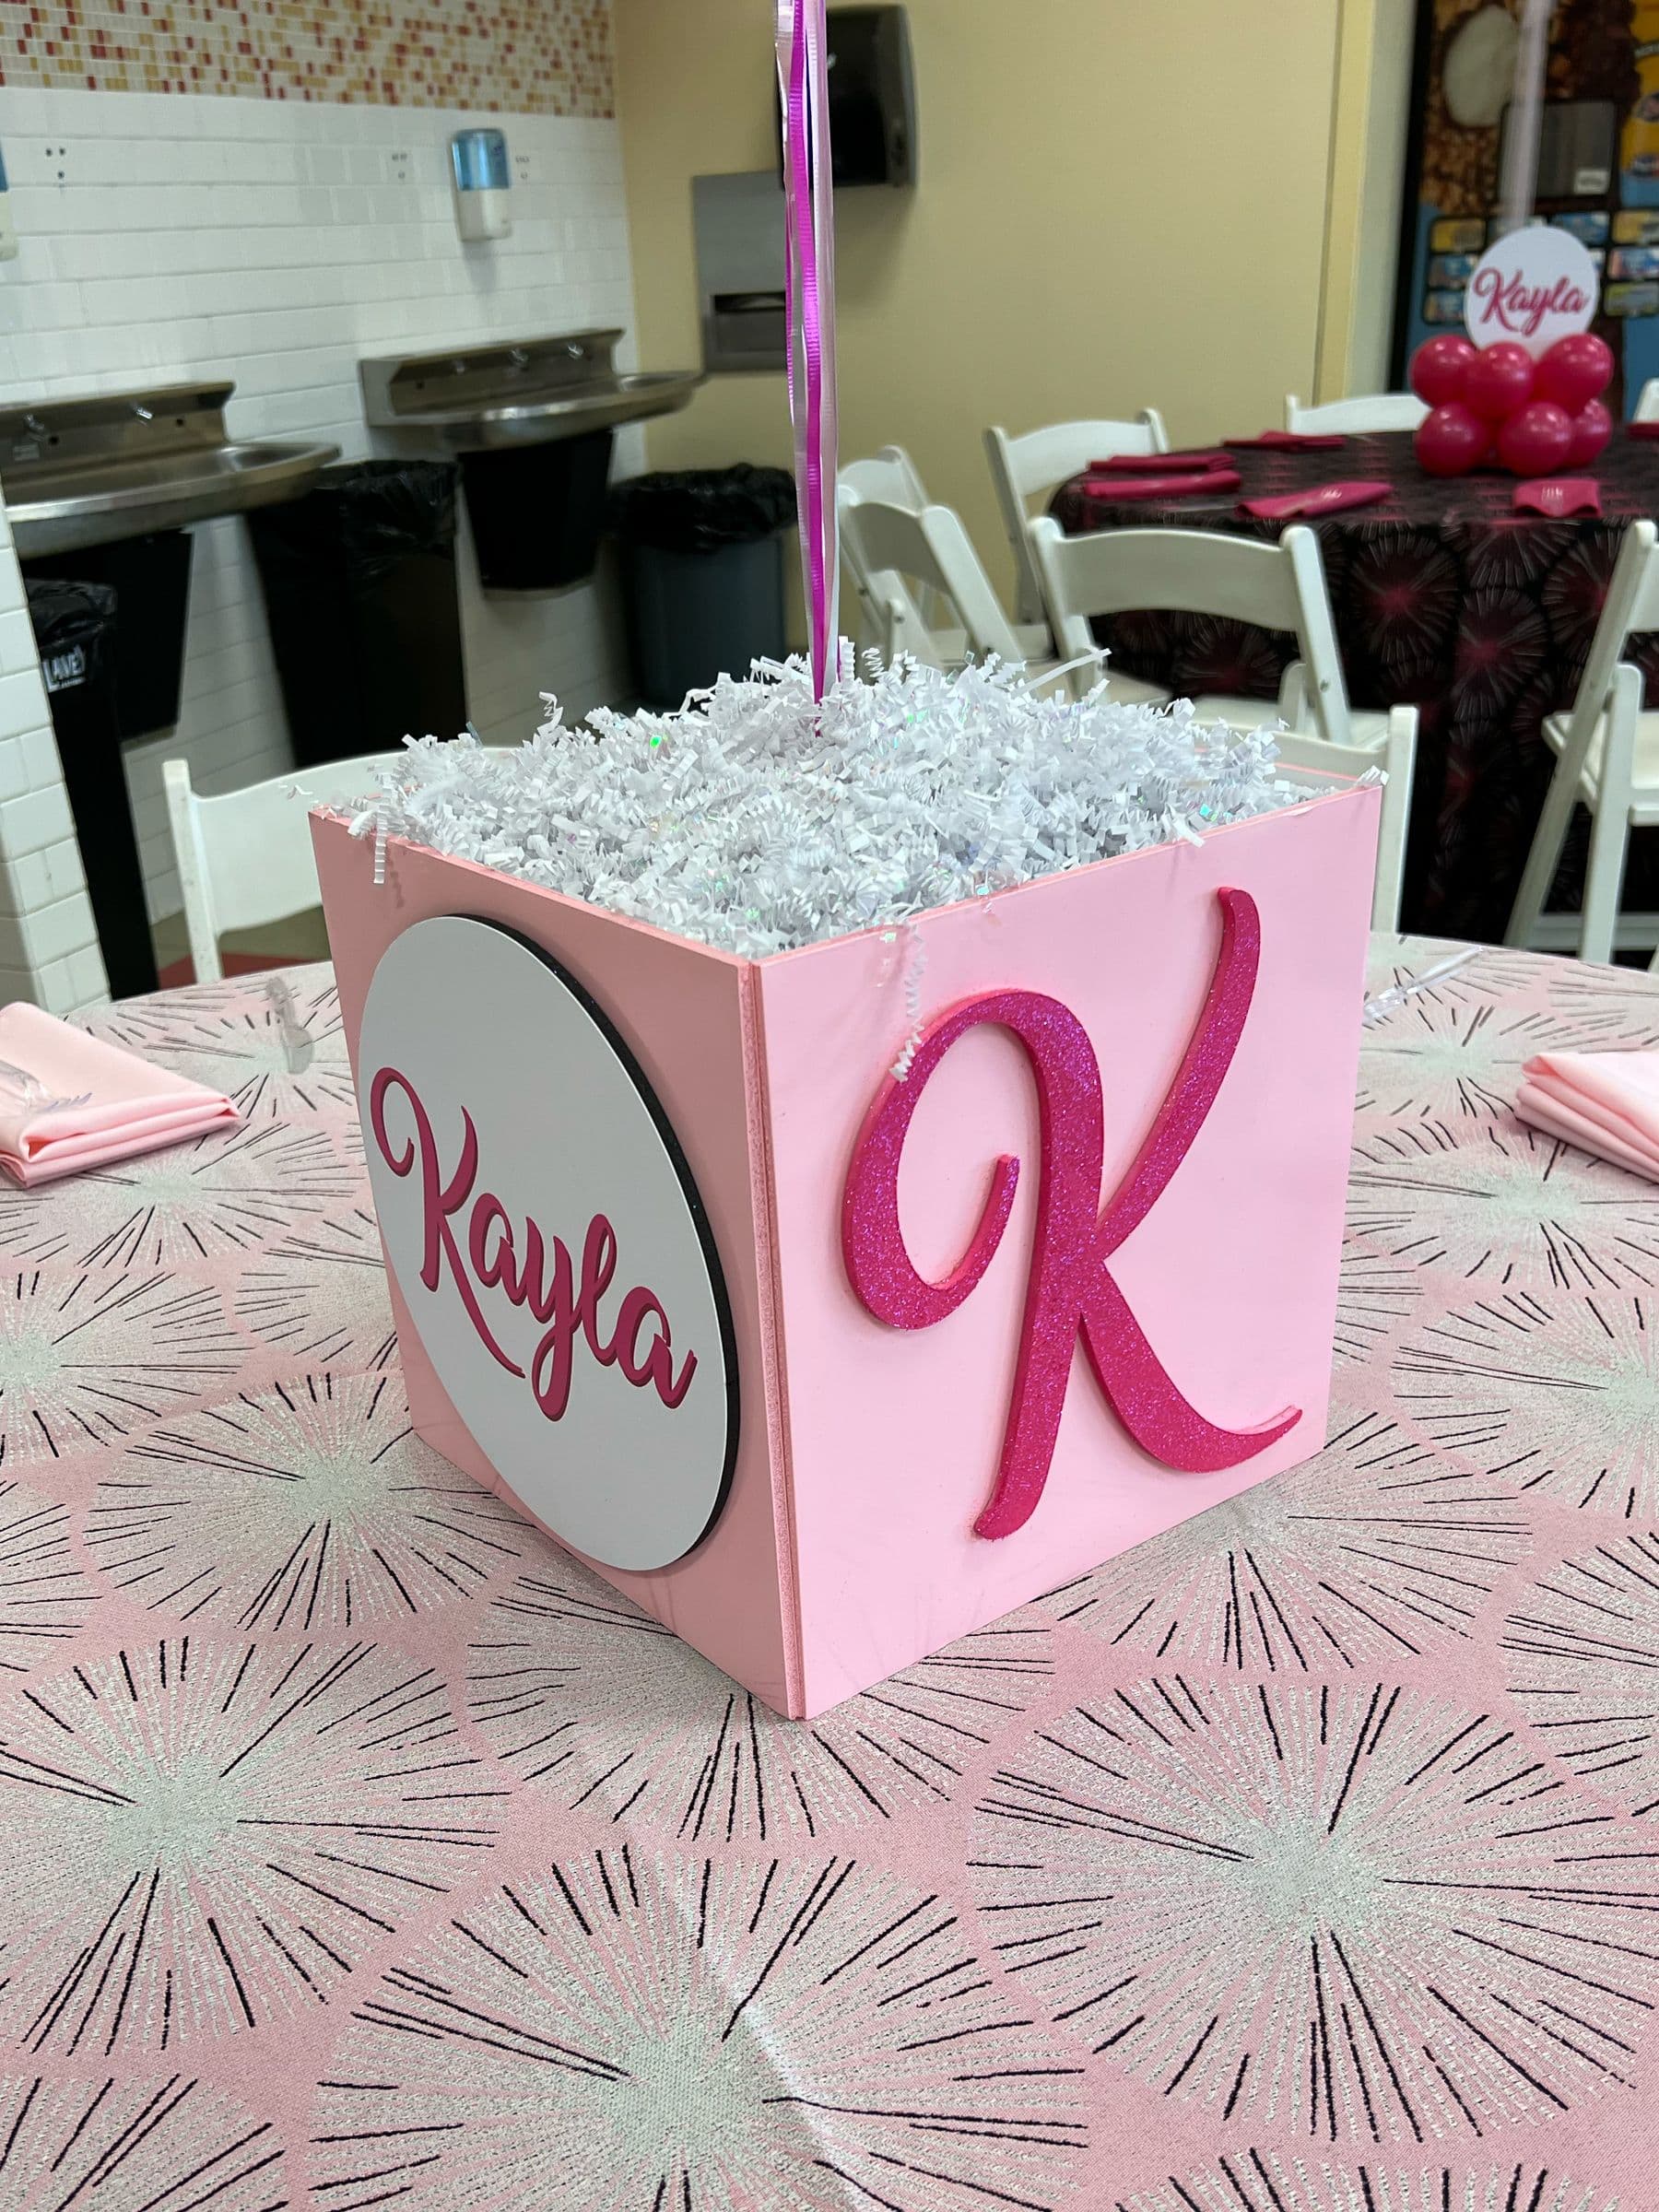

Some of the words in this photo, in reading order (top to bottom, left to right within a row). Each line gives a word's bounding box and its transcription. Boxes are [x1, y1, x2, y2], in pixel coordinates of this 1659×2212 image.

[1475, 267, 1591, 337] Kayla
[371, 1067, 698, 1422] Kayla
[841, 887, 1302, 1540] K
